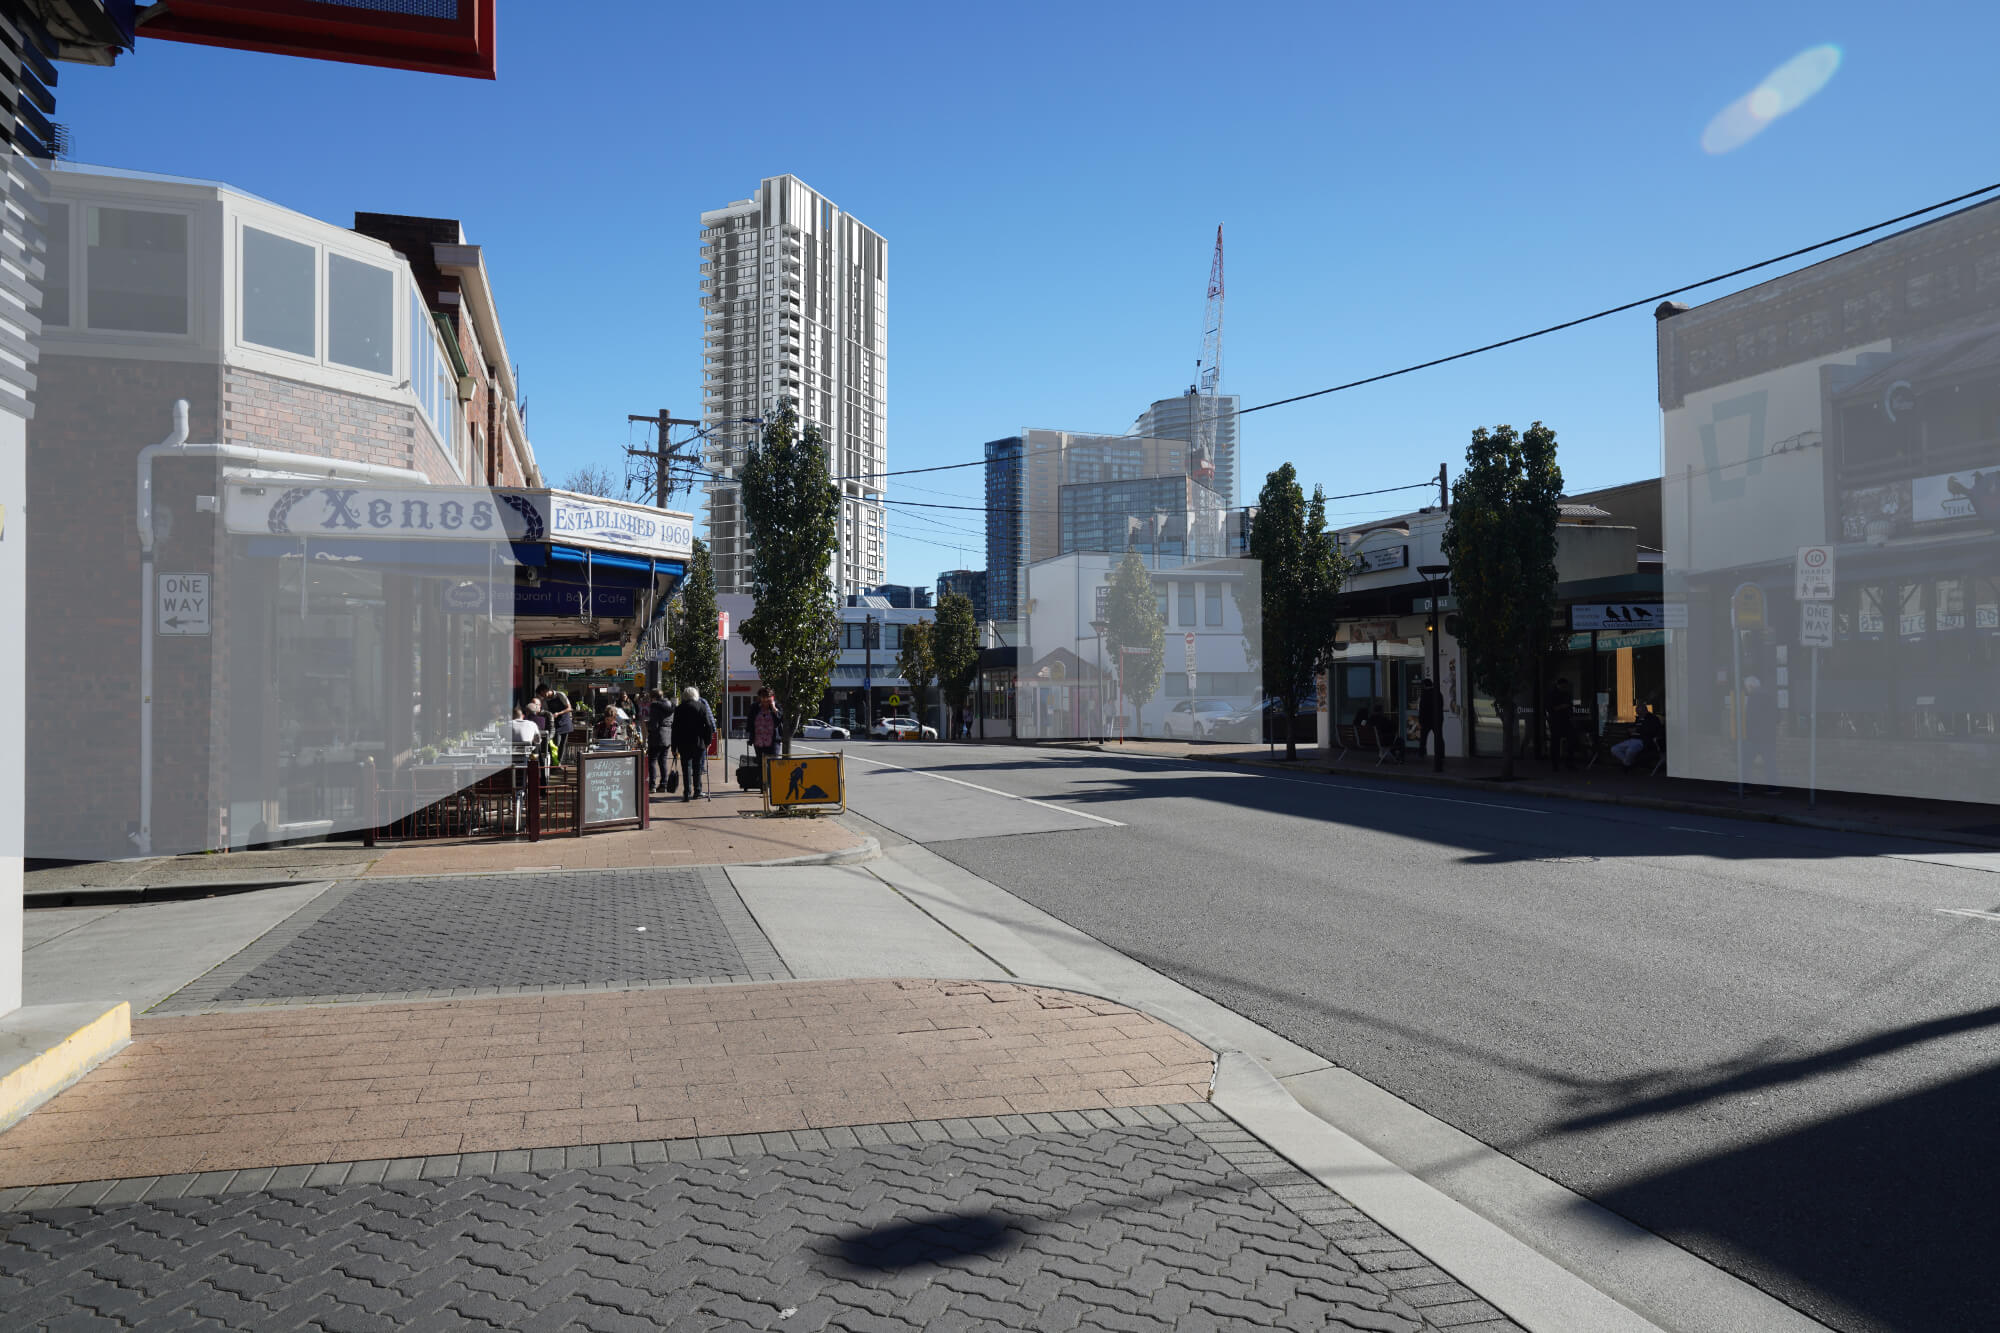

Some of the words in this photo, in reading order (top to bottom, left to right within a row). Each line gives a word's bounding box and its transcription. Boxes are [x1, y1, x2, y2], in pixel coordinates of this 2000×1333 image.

[319, 489, 493, 531] Xenos
[554, 508, 656, 537] ESTABLISHED
[660, 524, 690, 545] 1969
[166, 579, 202, 593] ONE
[491, 590, 552, 601] Restaurant
[600, 593, 626, 604] Cafe
[163, 598, 204, 613] WAY
[1807, 608, 1829, 617] ONE
[1805, 621, 1830, 631] WAY
[533, 647, 568, 657] WHY
[570, 647, 600, 656] NOT
[596, 789, 623, 817] 55
